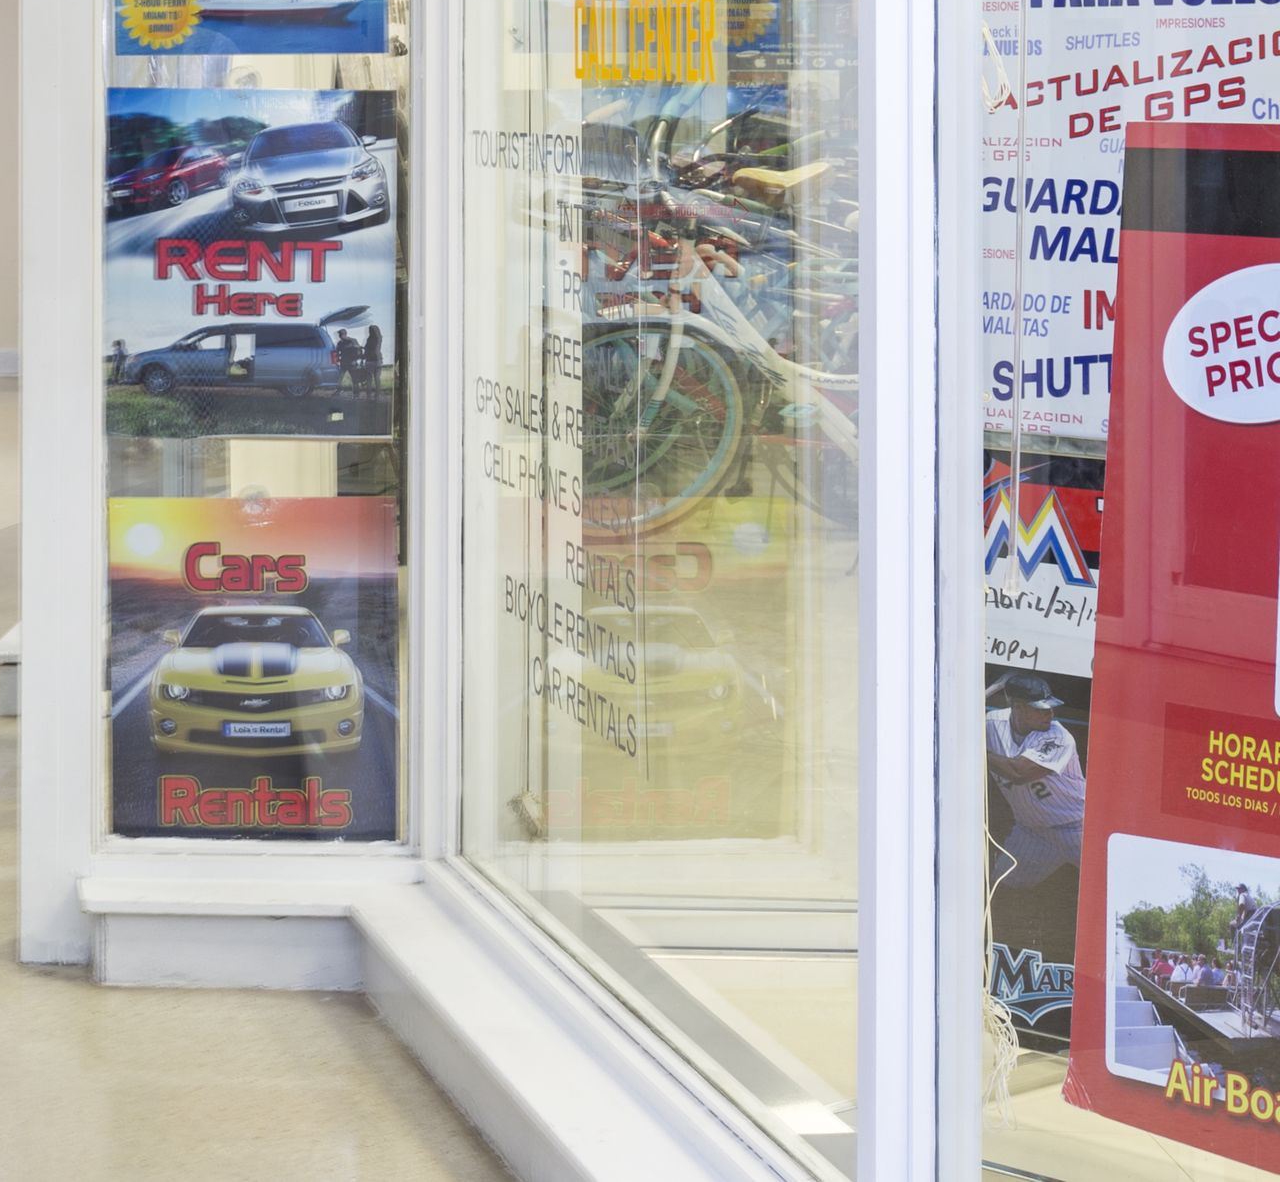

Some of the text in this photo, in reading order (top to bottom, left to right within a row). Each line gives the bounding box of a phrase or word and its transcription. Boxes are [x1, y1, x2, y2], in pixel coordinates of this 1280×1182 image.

[1065, 31, 1140, 51] SHUTTLES
[1155, 17, 1226, 29] IMPRESIONES
[1069, 76, 1247, 138] DE GPS
[473, 130, 529, 171] TOURIST
[983, 176, 1122, 216] GUARD
[153, 237, 343, 283] RENT
[192, 283, 304, 317] Here
[1051, 294, 1072, 315] DE
[544, 332, 582, 381] FREE
[1188, 309, 1280, 359] SPEC
[475, 376, 502, 420] GPS
[505, 385, 549, 436] SALES
[552, 401, 561, 442] &
[483, 441, 515, 488] CELL
[519, 454, 568, 512] PHONE
[182, 541, 308, 594] Cars
[566, 540, 636, 614] RENTALS
[505, 575, 637, 685] BICYCLE RENTALS
[533, 656, 637, 758] CAR RENTALS
[157, 775, 353, 828] Rentals
[1186, 787, 1269, 814] TODOS LOS DIAS
[1165, 1061, 1221, 1108] Air
